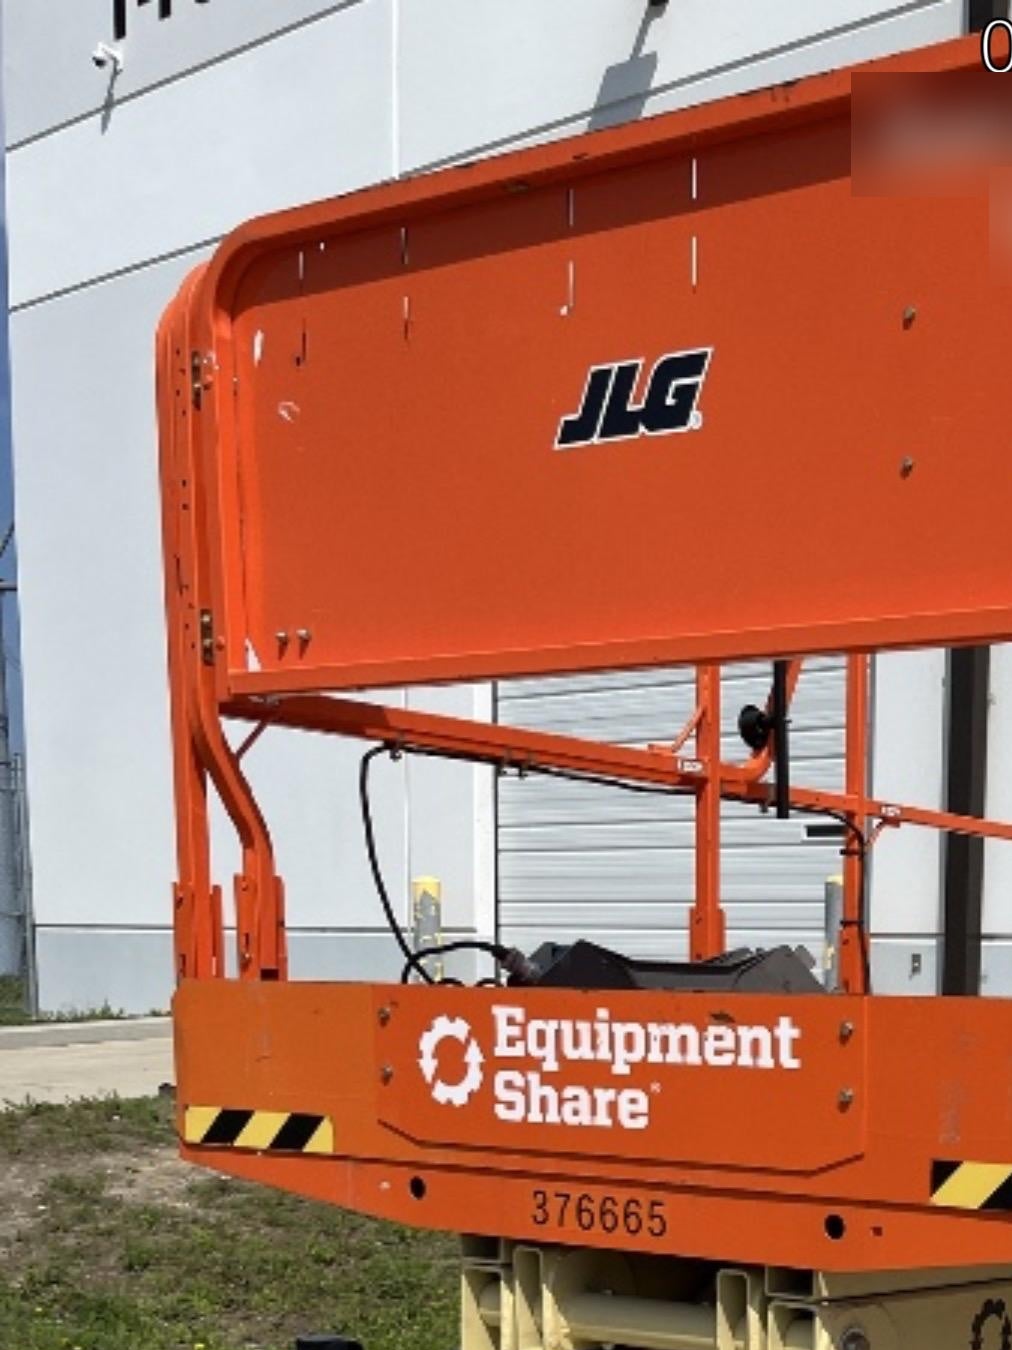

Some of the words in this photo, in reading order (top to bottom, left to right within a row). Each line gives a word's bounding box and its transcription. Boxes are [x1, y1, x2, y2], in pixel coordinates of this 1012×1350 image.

[553, 346, 714, 450] JLG
[491, 1004, 801, 1076] Equipment
[493, 1070, 650, 1130] Share
[531, 1189, 668, 1238] 376665
